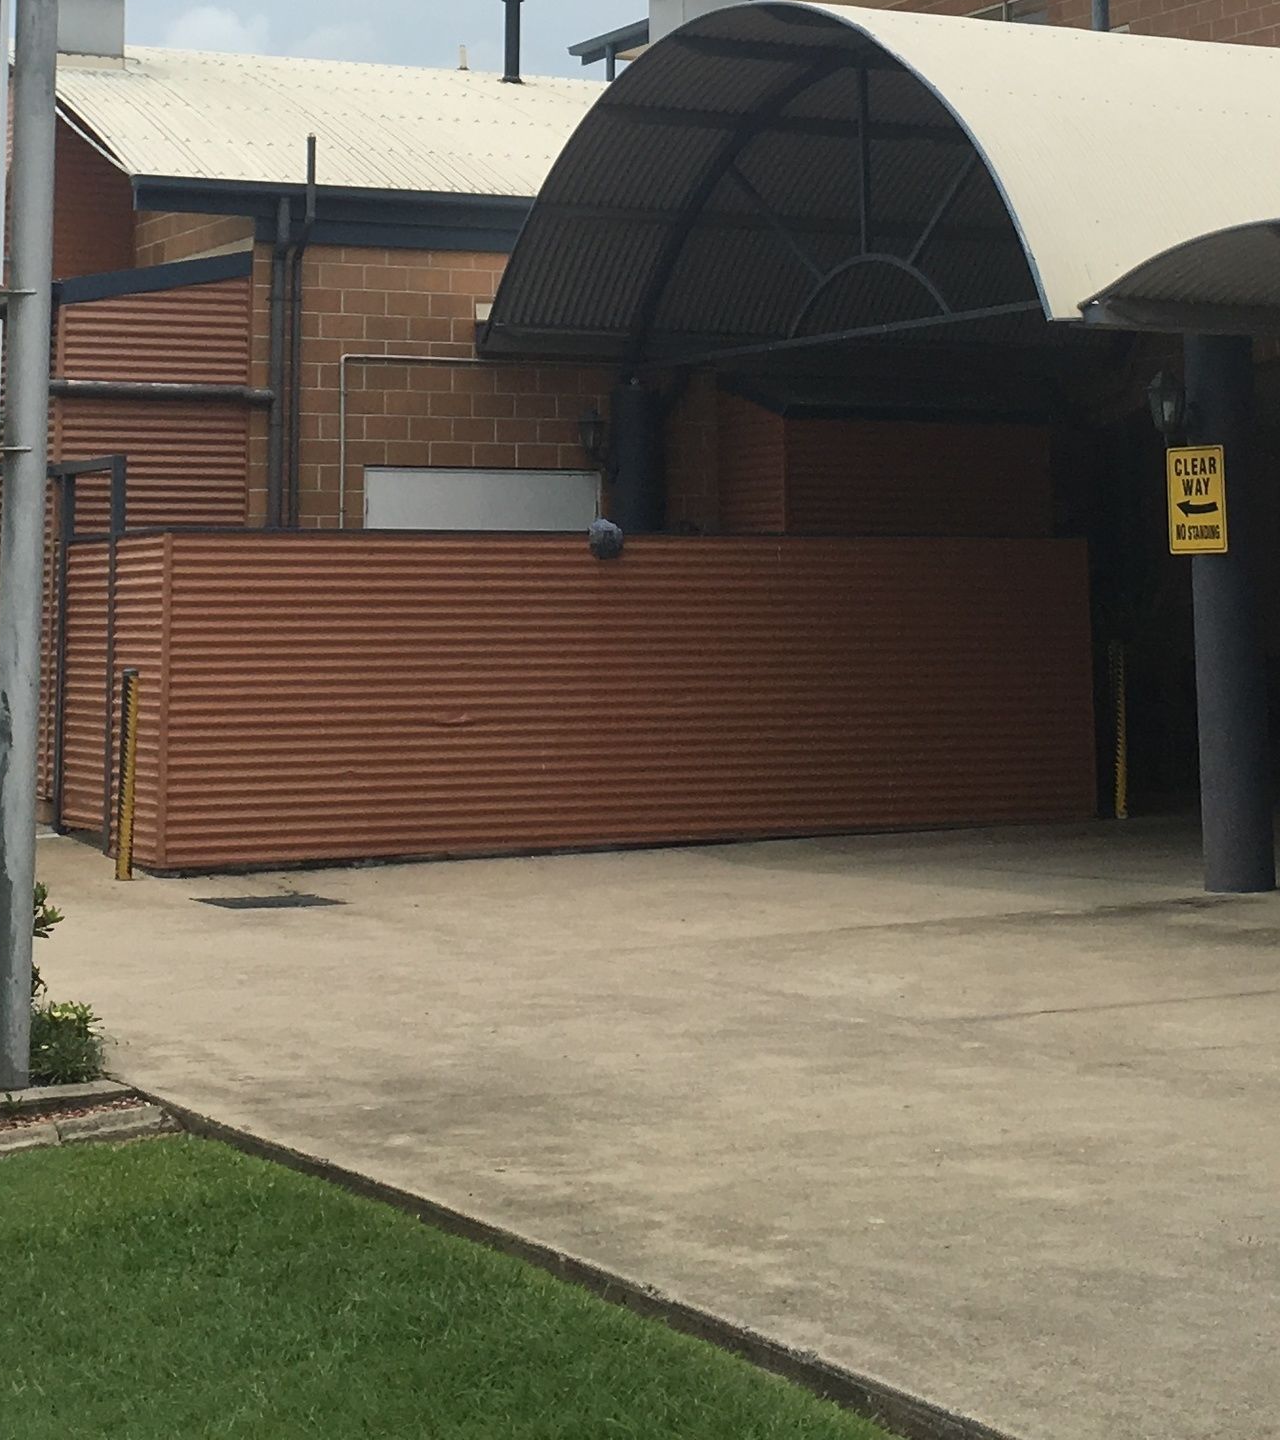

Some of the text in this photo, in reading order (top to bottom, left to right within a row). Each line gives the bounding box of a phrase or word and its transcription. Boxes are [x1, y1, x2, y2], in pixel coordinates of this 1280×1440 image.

[1175, 457, 1217, 476] CLEAR
[1182, 478, 1210, 495] WAY
[1176, 524, 1220, 540] NO STANDING
